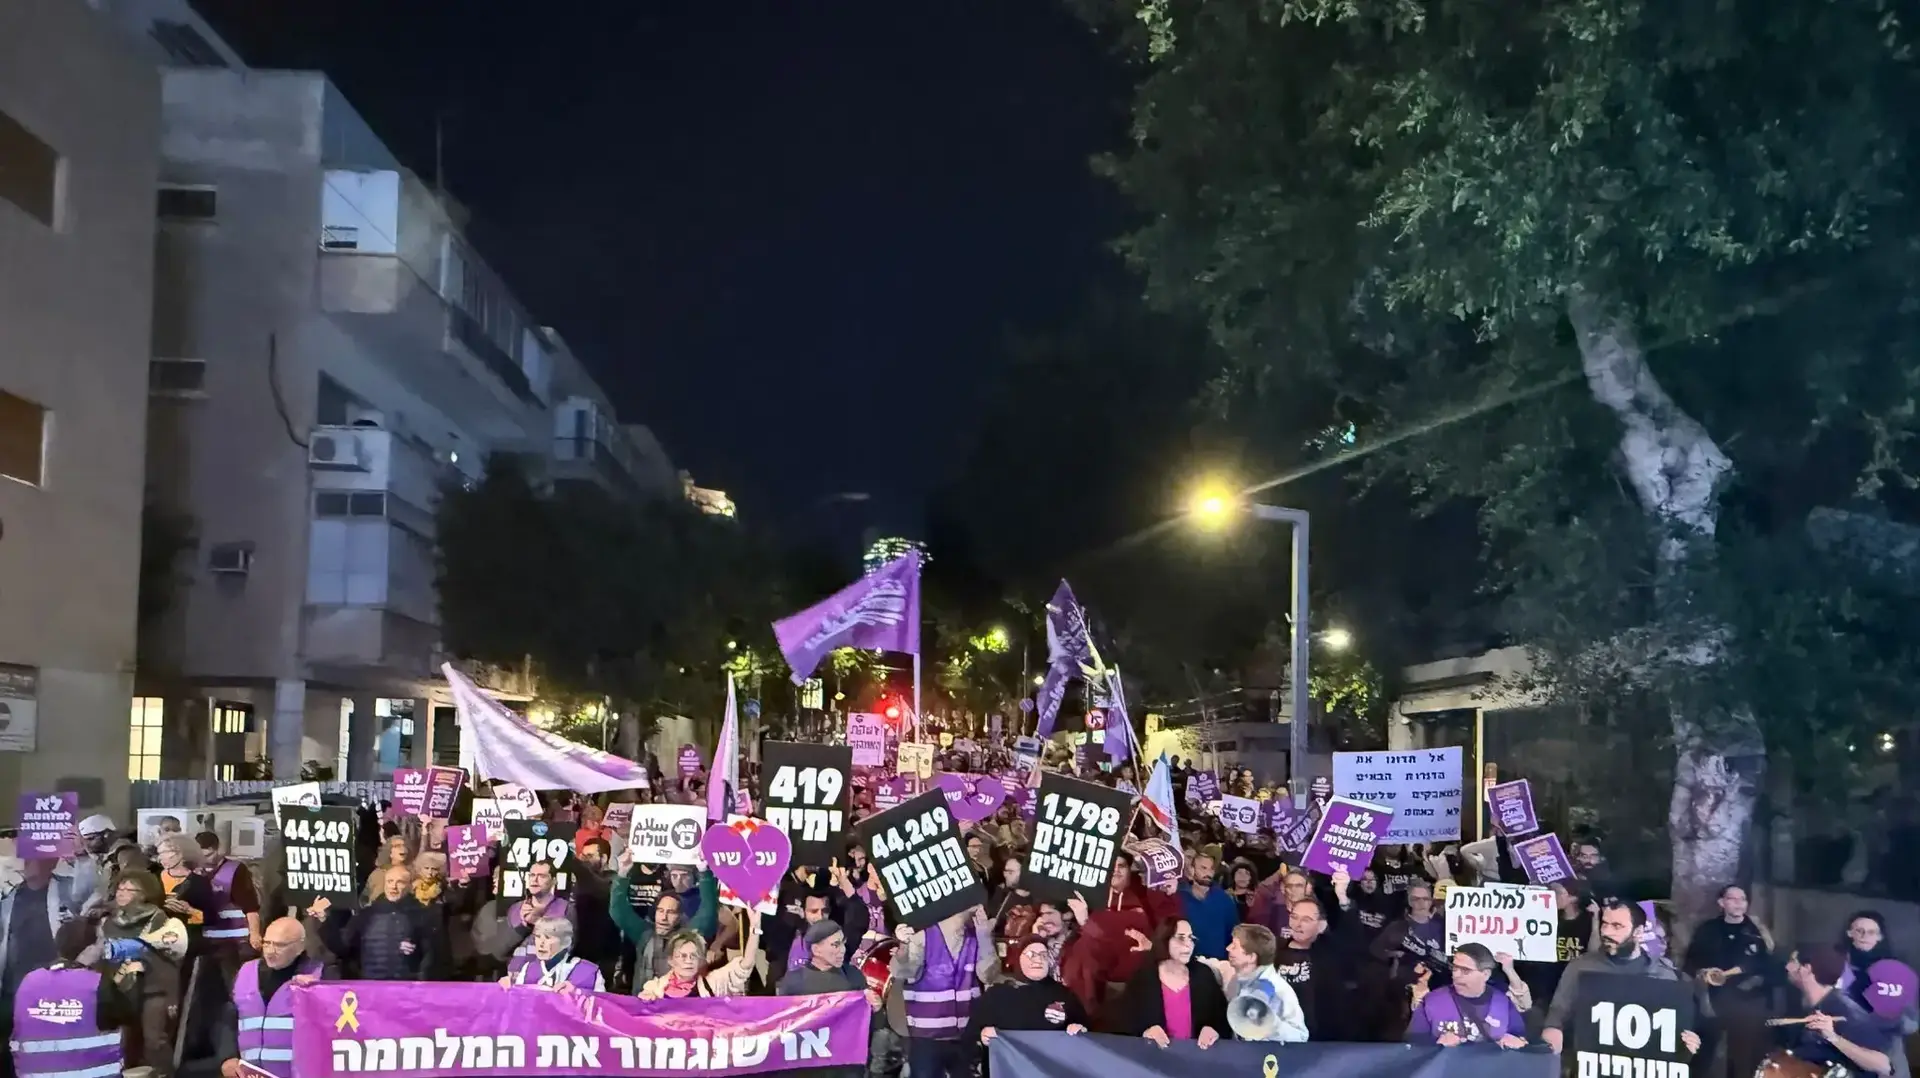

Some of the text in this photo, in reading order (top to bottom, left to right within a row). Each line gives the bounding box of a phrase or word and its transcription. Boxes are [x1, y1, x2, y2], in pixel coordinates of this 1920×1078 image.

[1356, 755, 1373, 764] את
[1429, 753, 1445, 762] אל
[768, 766, 844, 805] 419
[36, 795, 62, 810] לא
[765, 806, 842, 842] ימים
[1043, 793, 1120, 836] 1,798
[1344, 812, 1374, 829] לא
[284, 819, 350, 844] 44,249
[632, 832, 668, 847] שלום
[872, 806, 949, 858] 44,249
[1322, 834, 1373, 852] התנחלות
[1328, 824, 1376, 842] למלחמת
[507, 838, 568, 869] 419
[1033, 822, 1114, 868] הרוגים
[1328, 846, 1357, 860] בעזה
[286, 846, 350, 873] הרוגים
[755, 851, 777, 866] עכ
[881, 836, 966, 894] הרוגים
[1028, 852, 1108, 888] ישראלים
[287, 872, 351, 892] פלסטינים
[894, 865, 975, 916] פלסטינים
[1448, 889, 1552, 910] די למלחמת
[1458, 914, 1552, 936] כס נתניהו
[1876, 982, 1902, 996] עכ
[1591, 1001, 1676, 1053] 101
[332, 1027, 832, 1071] או שנגמור את המלחמה
